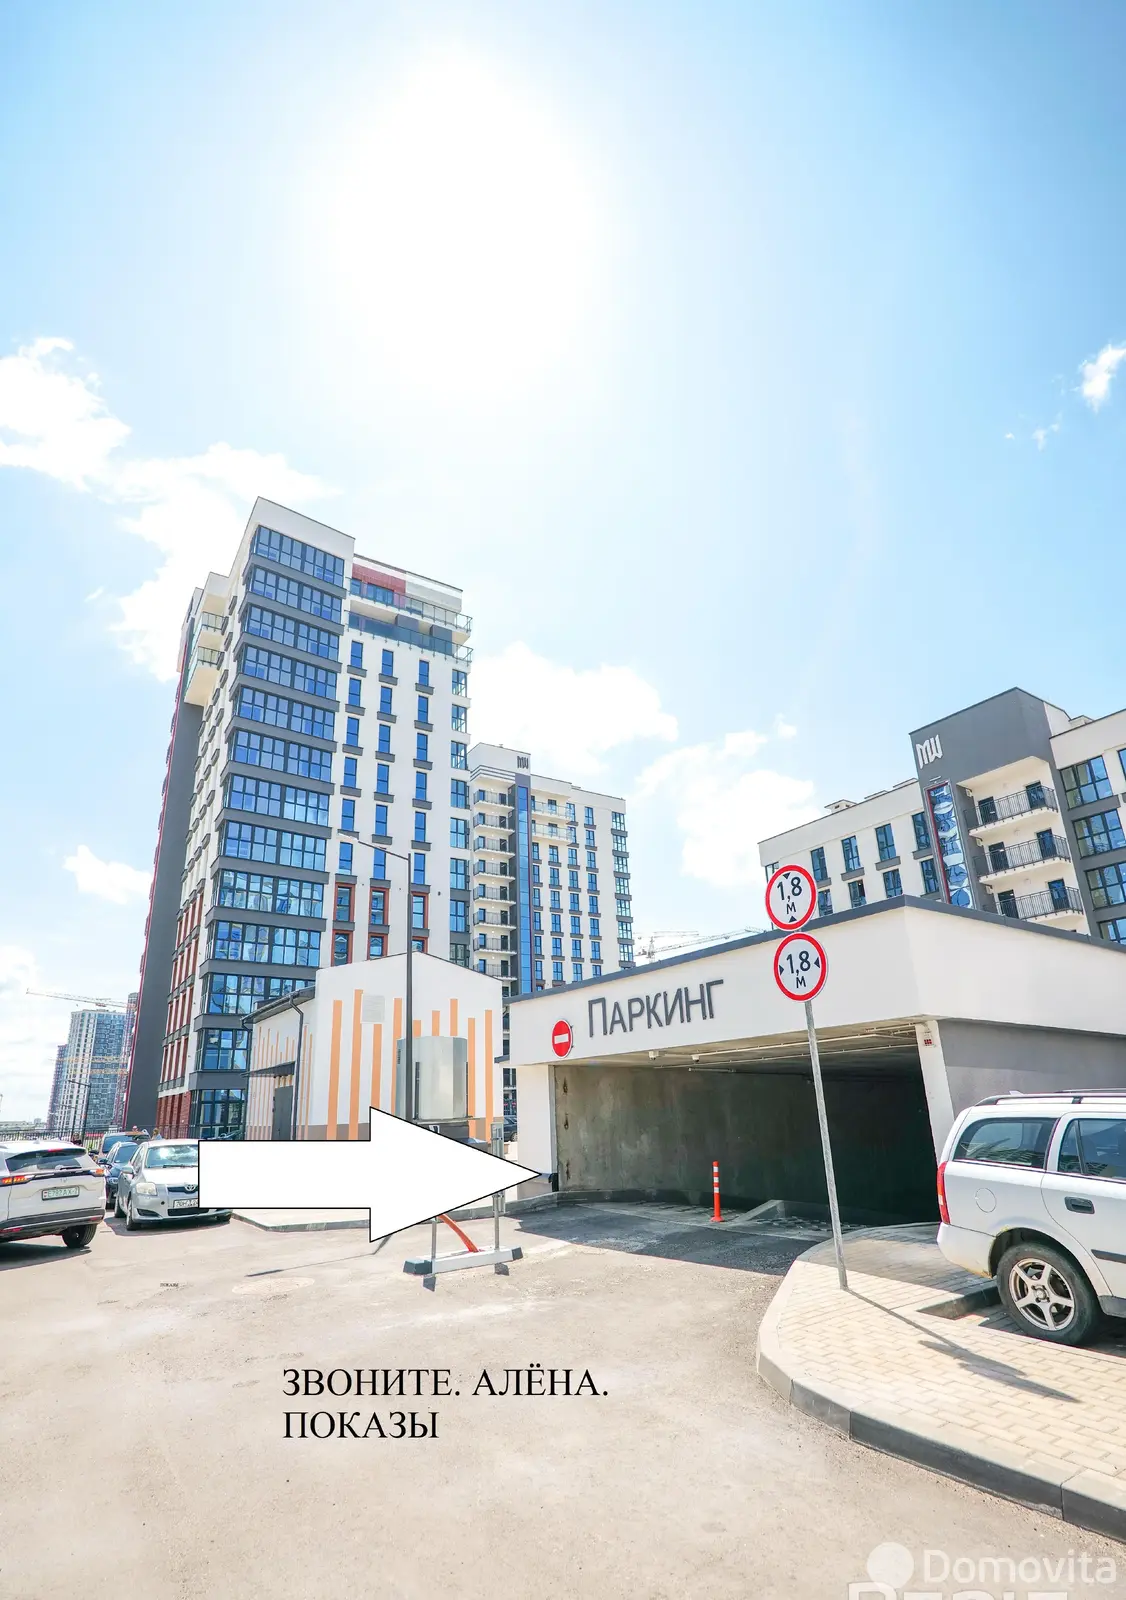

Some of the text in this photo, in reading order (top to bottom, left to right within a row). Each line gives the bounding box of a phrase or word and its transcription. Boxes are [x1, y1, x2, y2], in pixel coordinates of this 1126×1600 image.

[777, 876, 803, 902] 1,8
[786, 950, 811, 976] 1,8
[587, 979, 724, 1038] ПАРКИНГ
